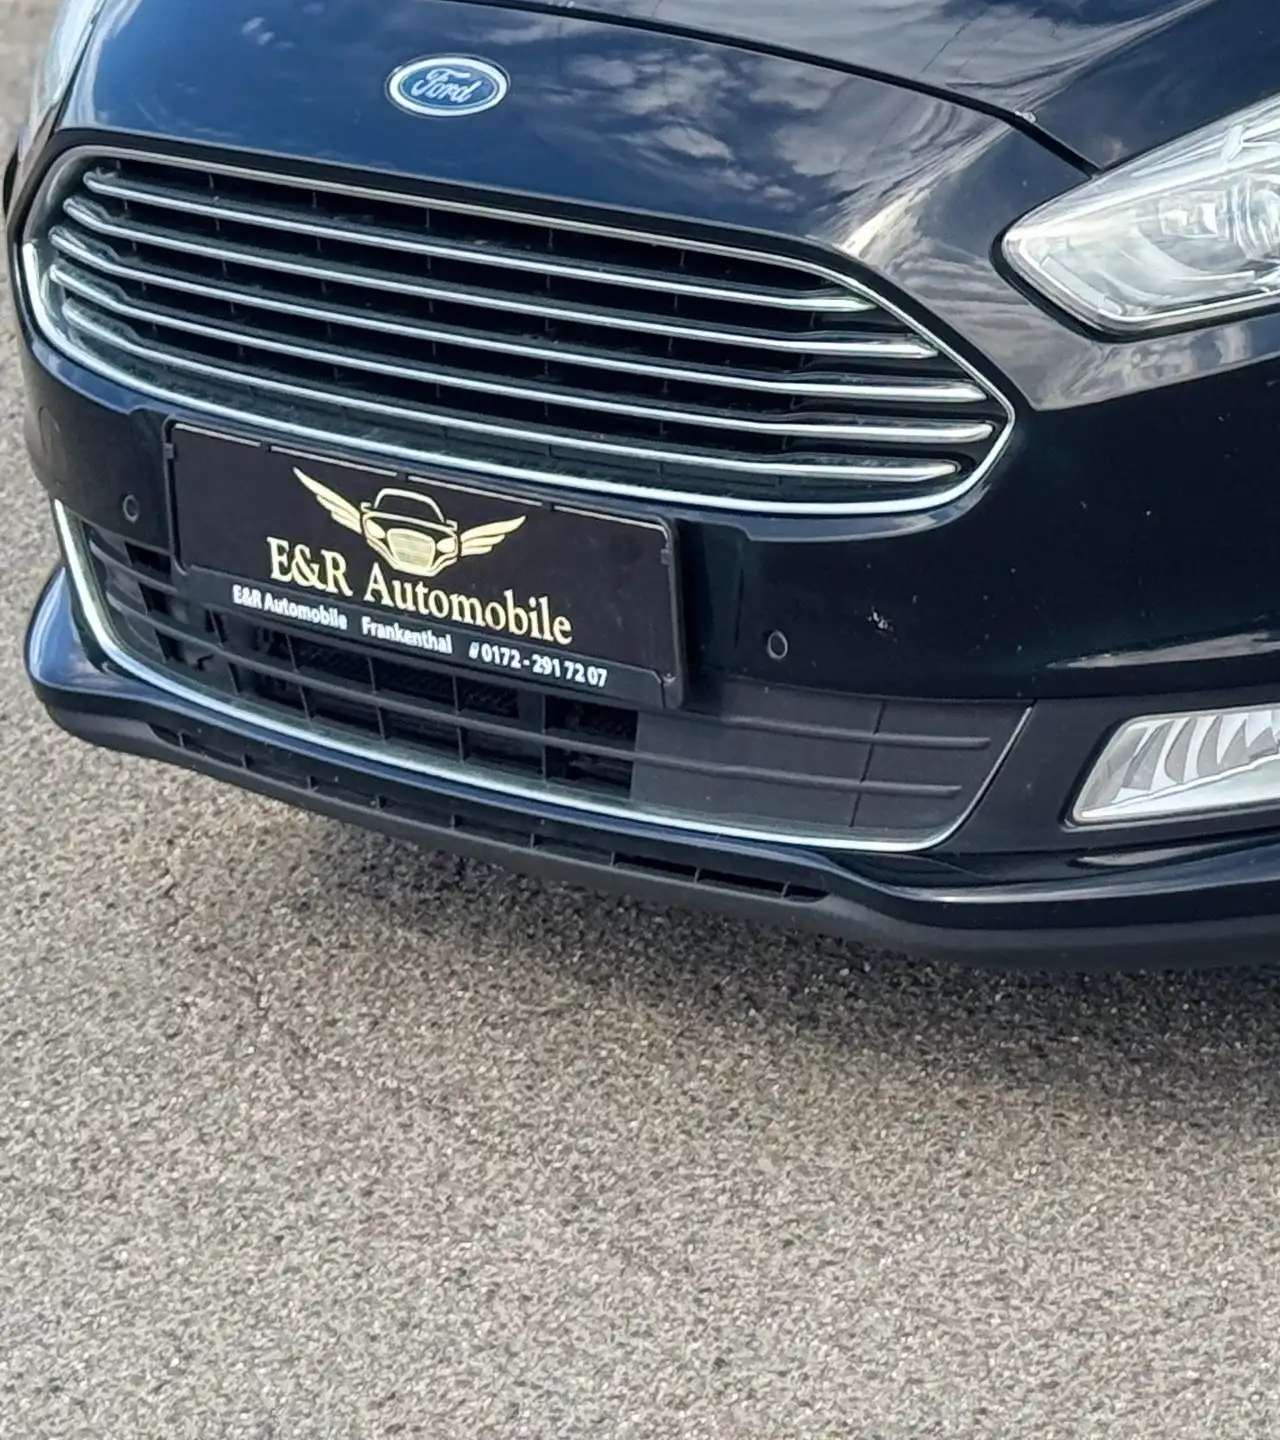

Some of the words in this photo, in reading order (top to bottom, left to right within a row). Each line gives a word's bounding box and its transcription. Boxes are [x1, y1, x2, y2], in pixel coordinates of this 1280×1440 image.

[411, 67, 483, 104] Ford
[232, 584, 262, 610] E&R
[263, 592, 348, 630] Automobile
[361, 615, 453, 655] Frankenthal
[266, 536, 354, 597] E&R
[363, 561, 574, 645] Automobile
